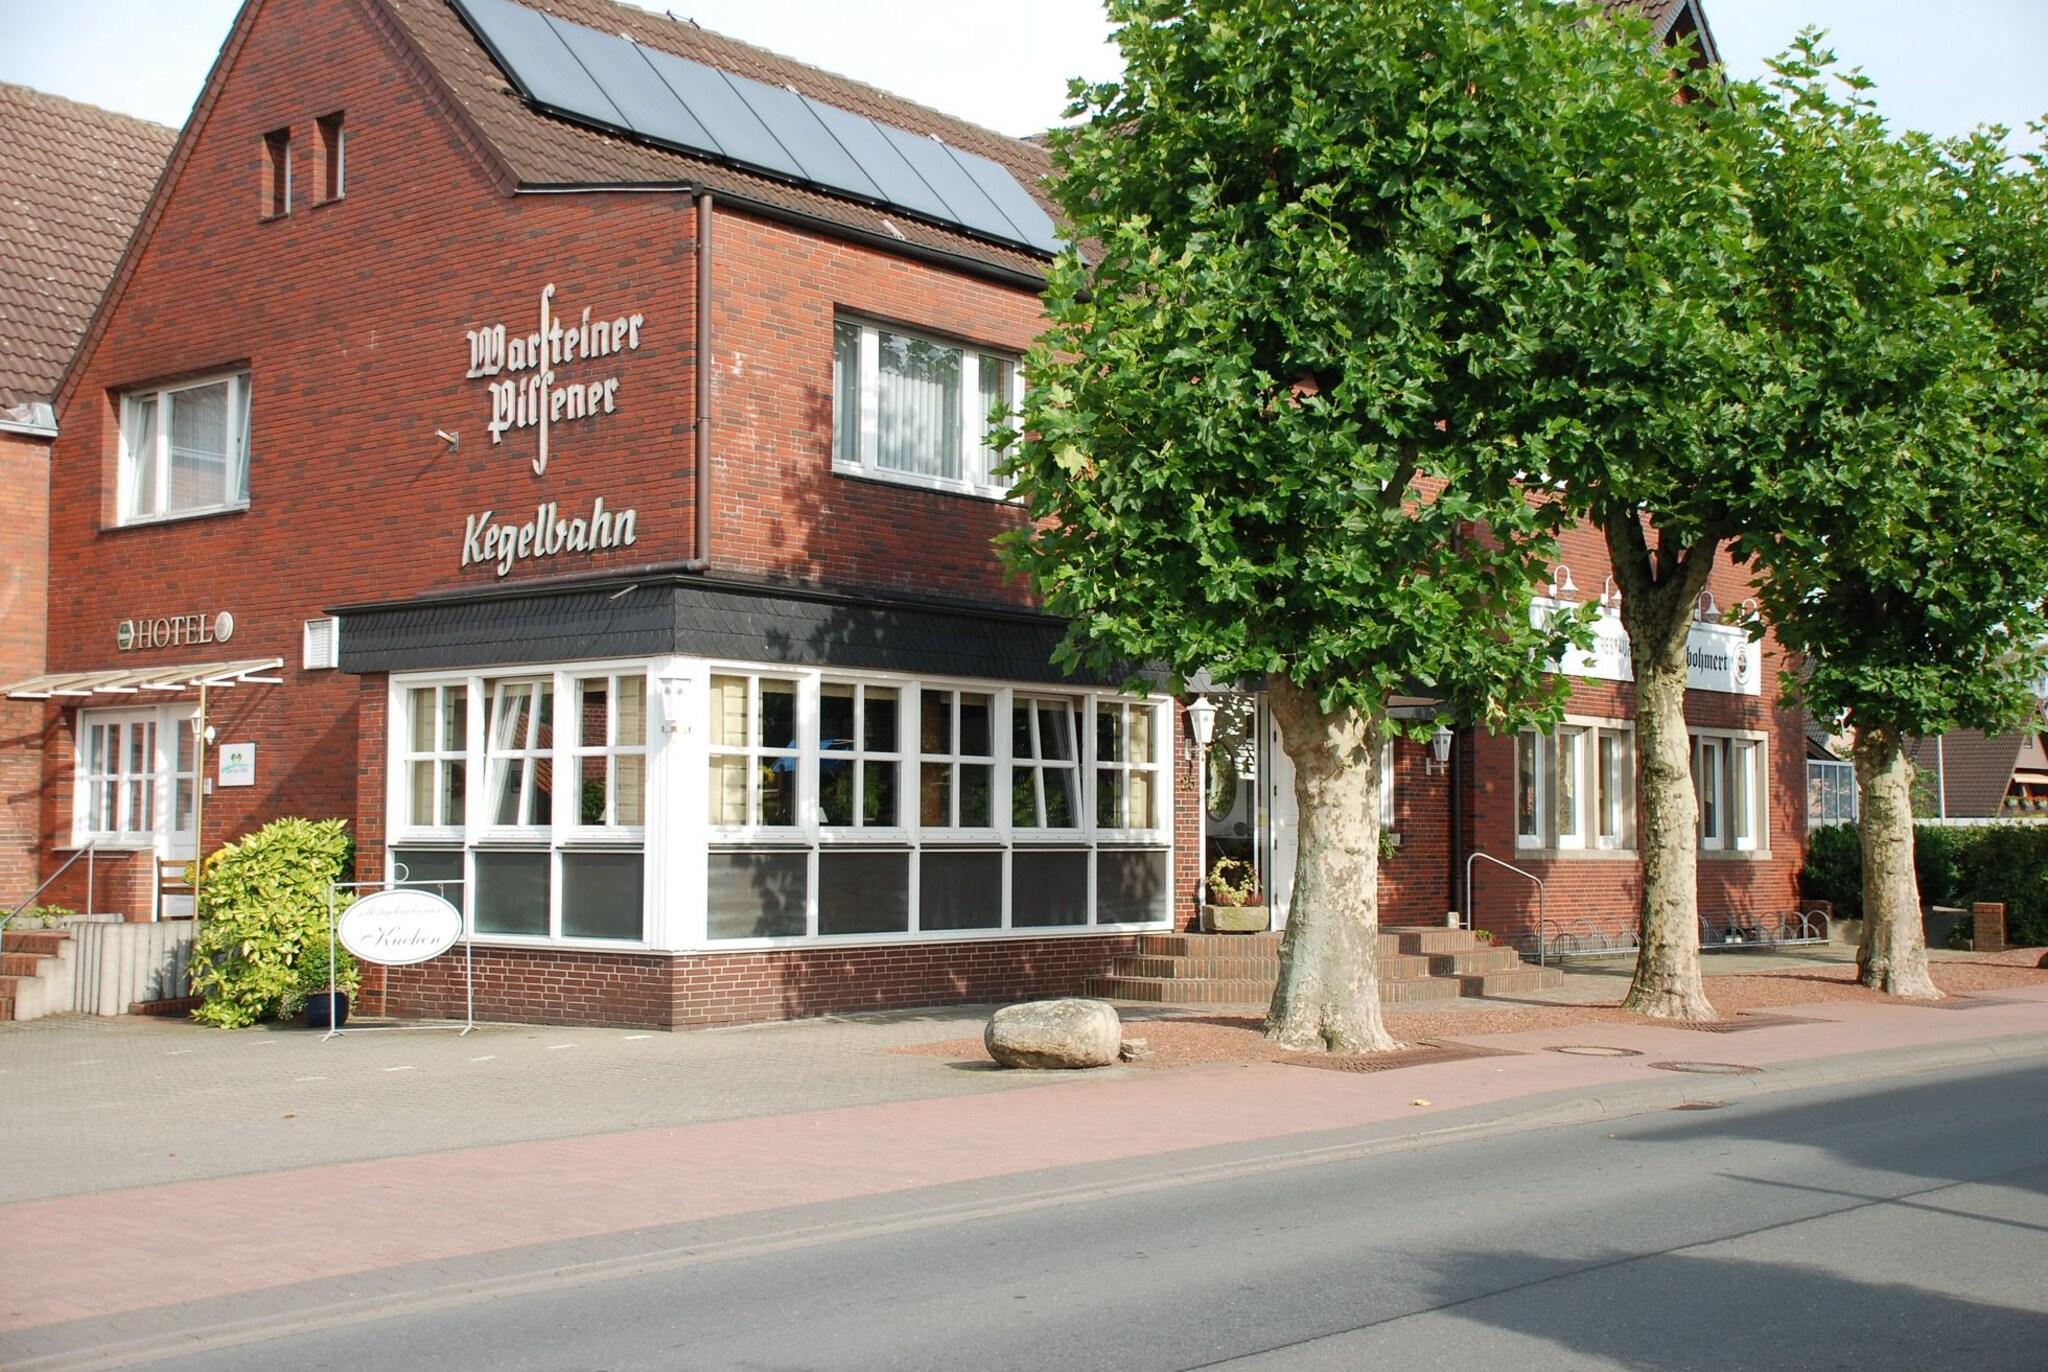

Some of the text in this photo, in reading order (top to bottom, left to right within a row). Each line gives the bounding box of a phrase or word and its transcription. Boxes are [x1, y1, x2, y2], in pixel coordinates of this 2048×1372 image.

[466, 283, 643, 378] Warsteiner
[462, 497, 636, 576] Kegelbahn
[138, 614, 213, 648] HOTEL
